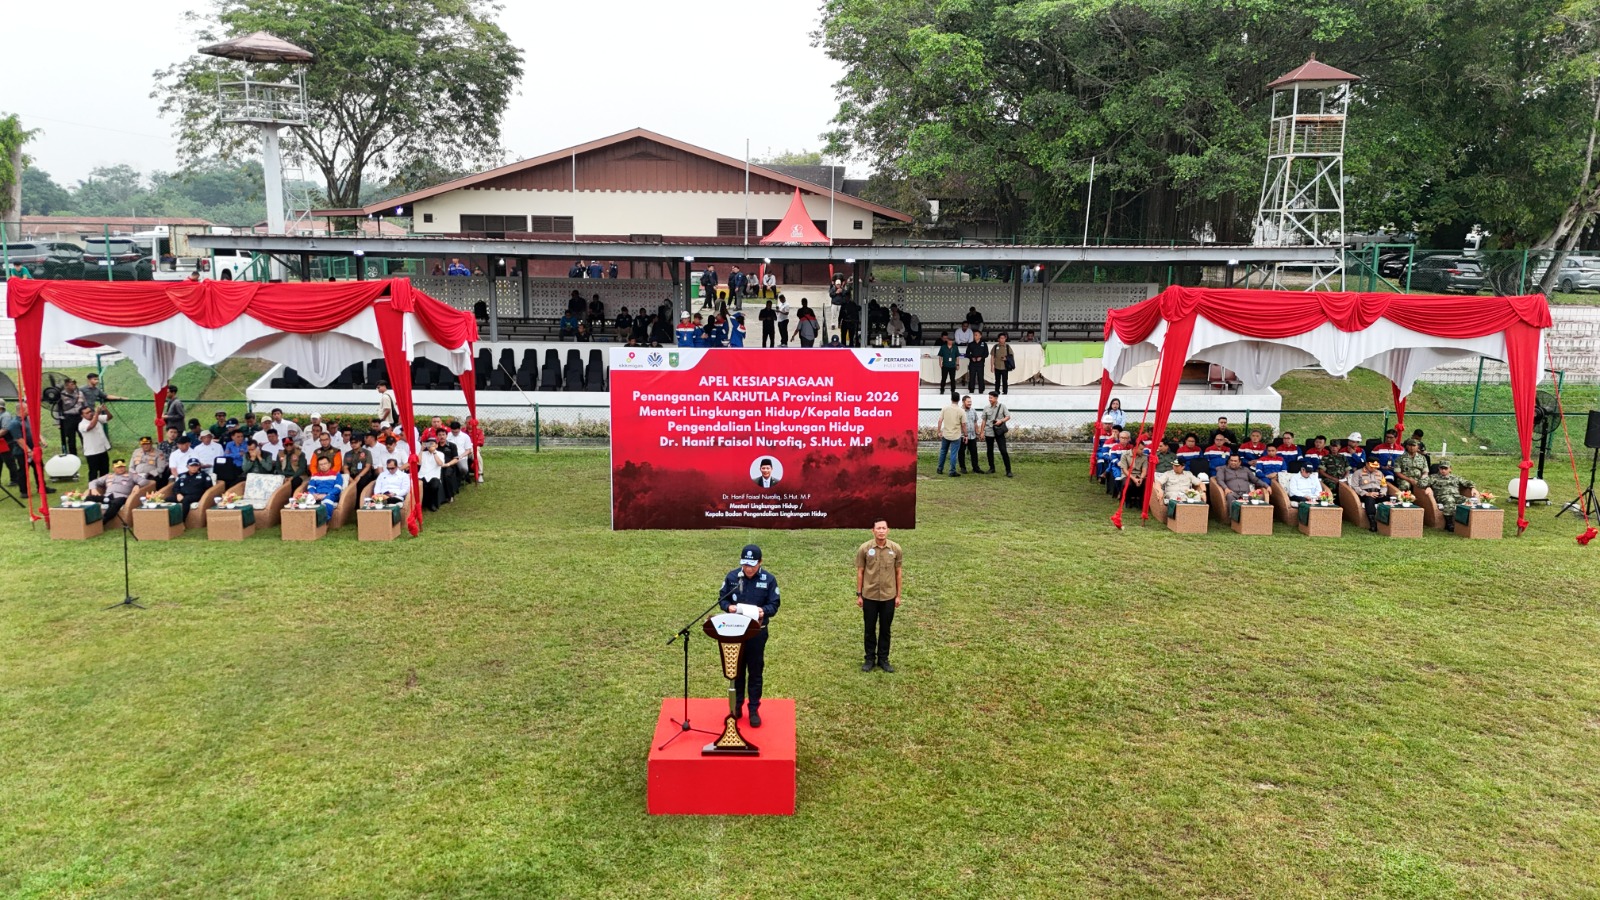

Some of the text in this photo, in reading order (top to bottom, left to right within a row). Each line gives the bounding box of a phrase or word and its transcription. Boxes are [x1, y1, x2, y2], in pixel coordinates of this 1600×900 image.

[698, 376, 834, 386] APEL KESIAPSIAGAAN
[633, 390, 899, 404] Penanganan KARHUTLA Provinsi Riau 2026
[640, 406, 892, 419] Menteri Lingkungan Hidup/Kepala Badan
[668, 421, 864, 434] Pengendalian Lingkungan Hidup
[660, 436, 872, 450] Dr. Hanif Faisol Nurofiq, S.Hut. M.P
